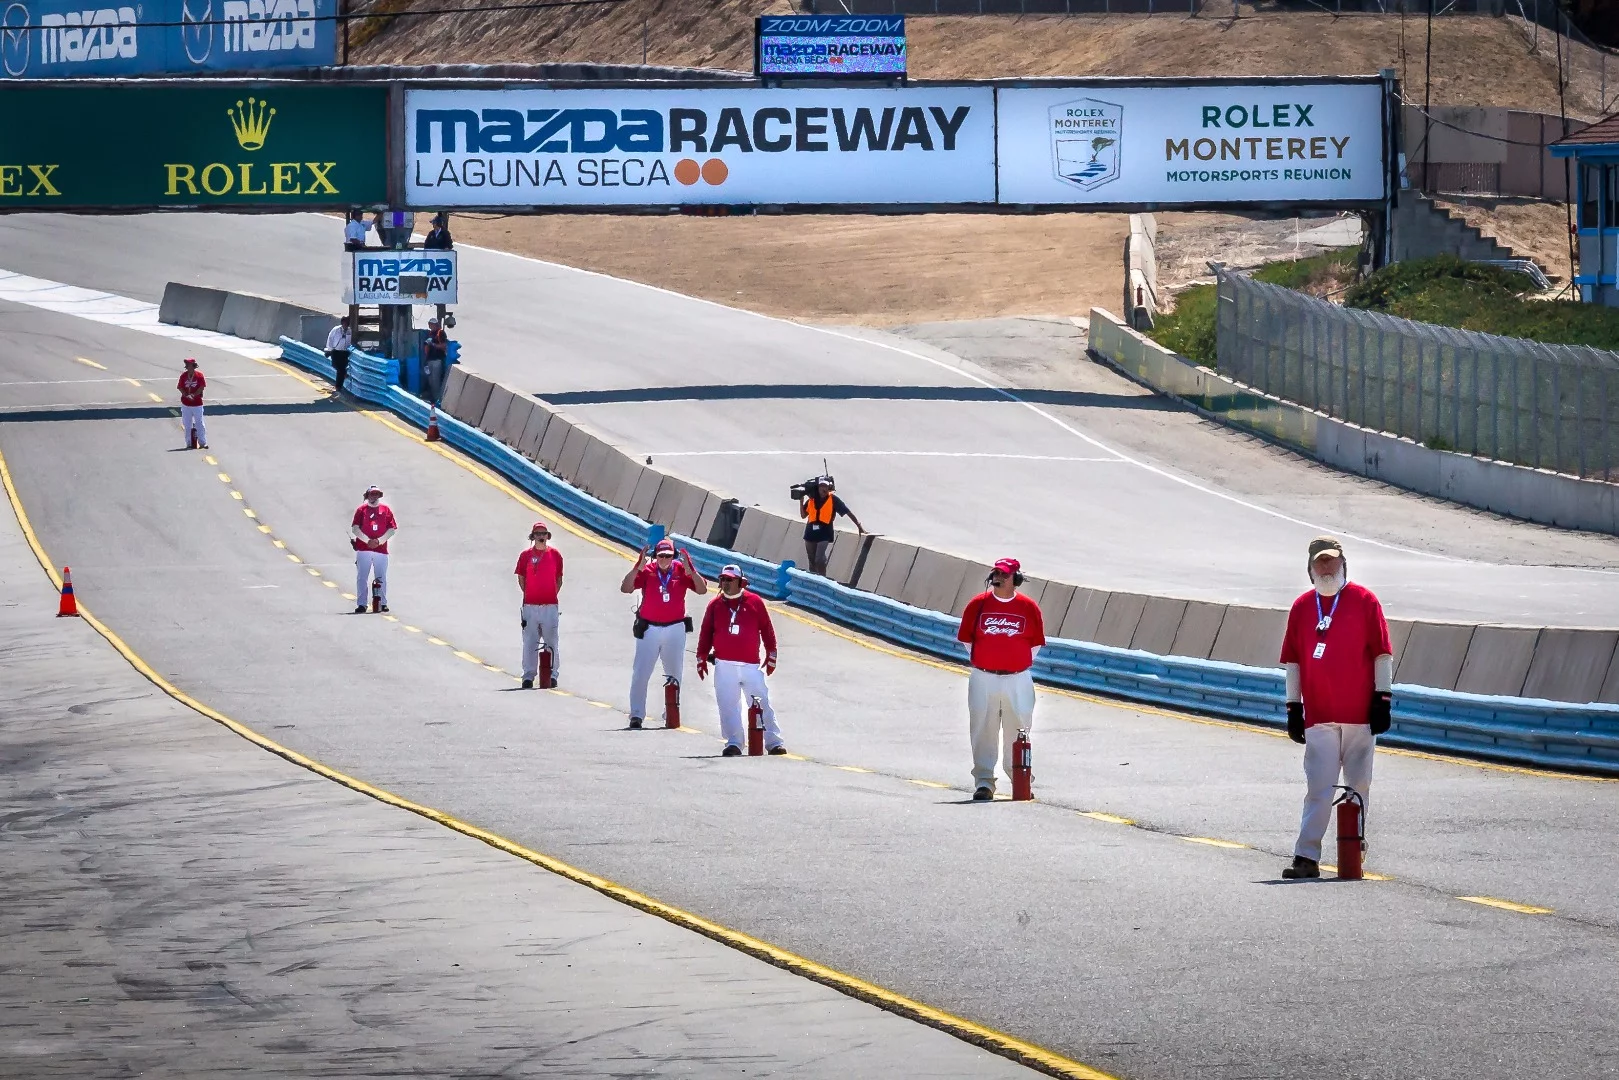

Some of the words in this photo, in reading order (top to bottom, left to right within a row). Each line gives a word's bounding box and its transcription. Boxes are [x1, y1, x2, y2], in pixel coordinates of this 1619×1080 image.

[764, 19, 902, 33] ZOOM-ZOOM
[828, 44, 904, 55] RACEWAY
[1066, 109, 1105, 117] ROLEX
[1202, 104, 1314, 129] ROLEX
[670, 106, 971, 153] RACEWAY
[1055, 119, 1116, 128] MONTEREY
[1166, 136, 1350, 161] MONTEREY
[164, 162, 339, 195] ROLEX
[415, 158, 566, 187] LAGUNA
[577, 158, 671, 187] SECA
[1166, 169, 1279, 182] MOTORSPORTS
[1284, 168, 1352, 180] REUNION
[358, 277, 453, 292] RACAY
